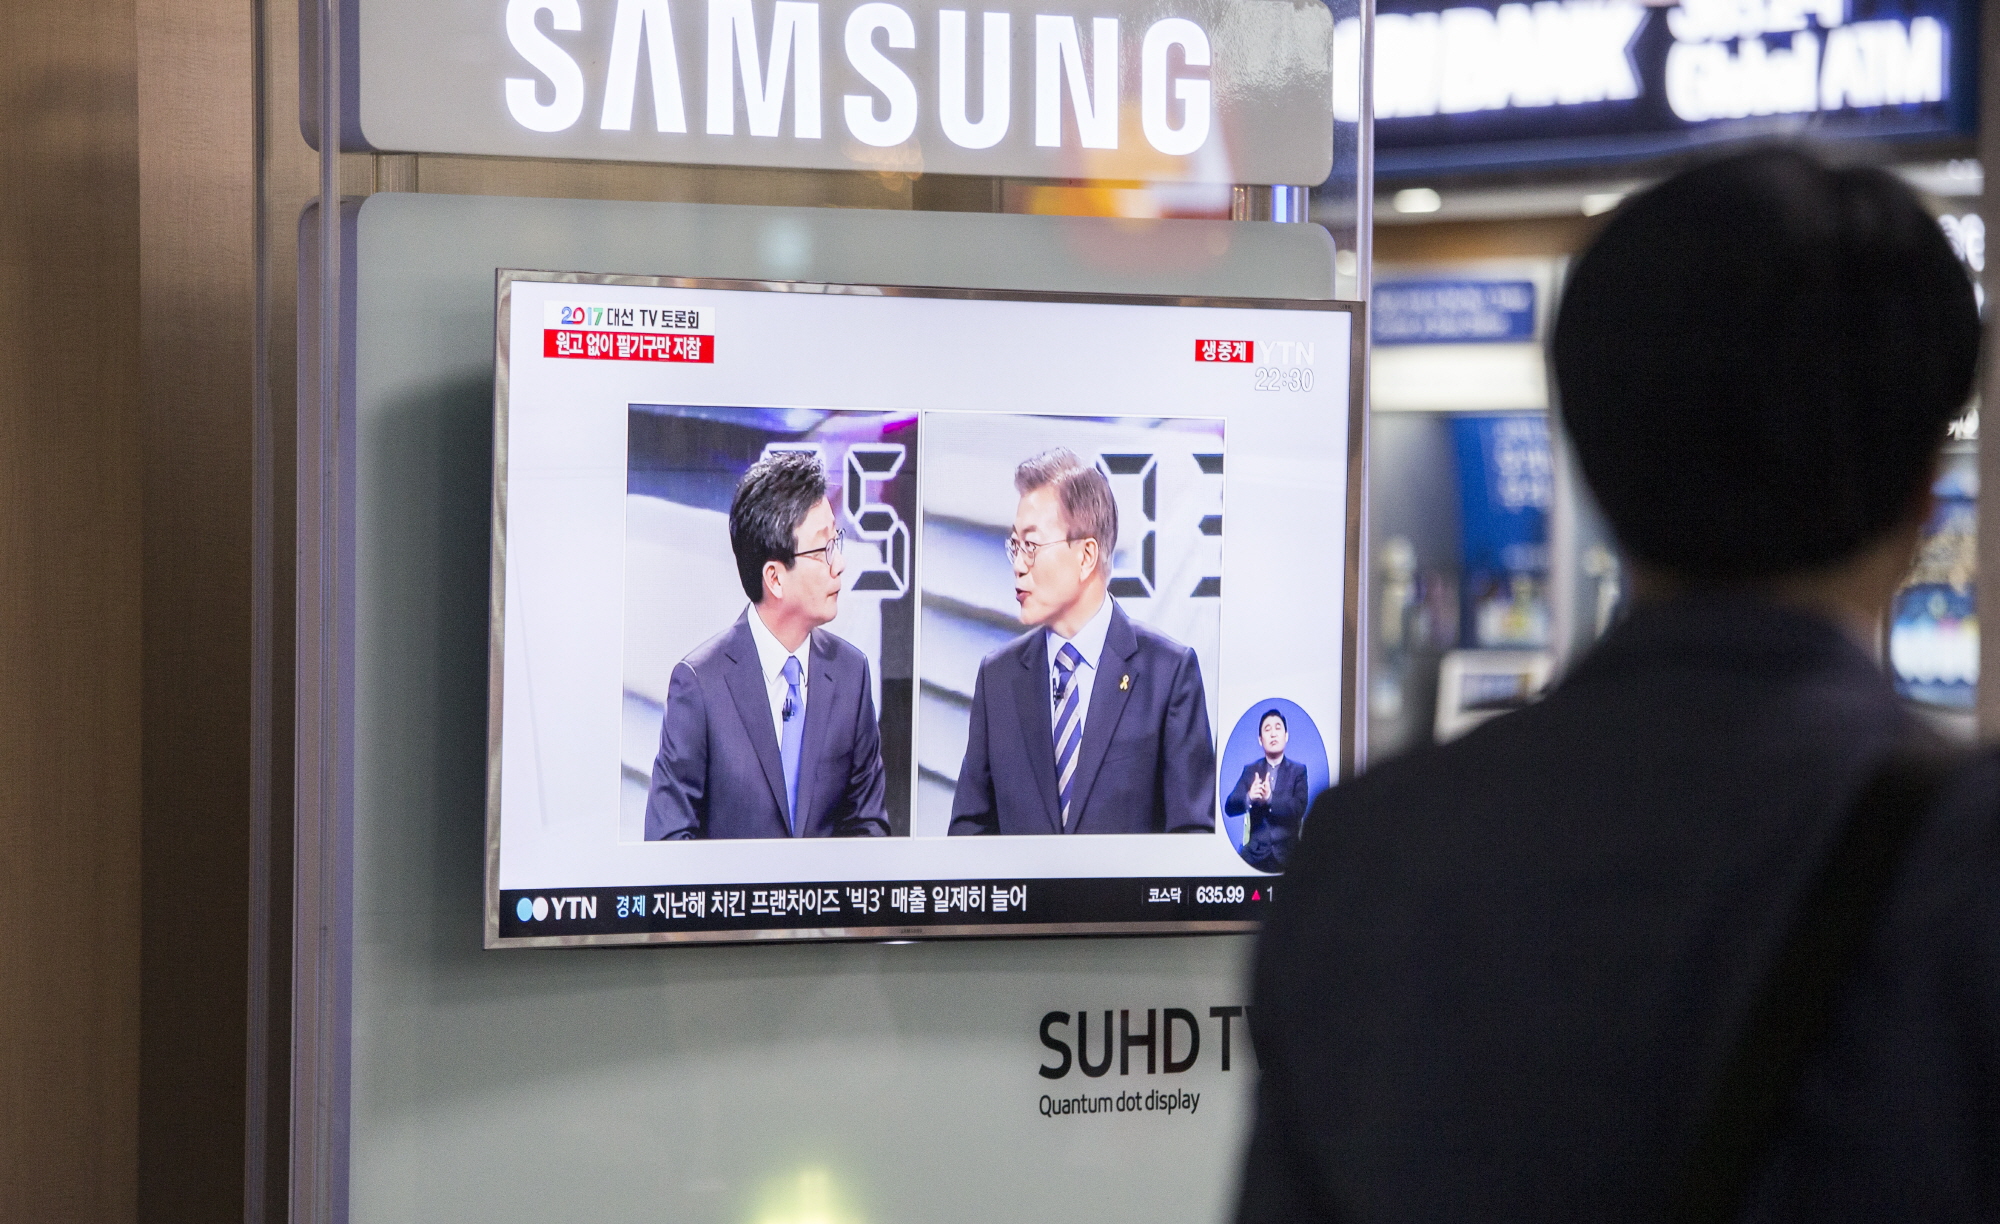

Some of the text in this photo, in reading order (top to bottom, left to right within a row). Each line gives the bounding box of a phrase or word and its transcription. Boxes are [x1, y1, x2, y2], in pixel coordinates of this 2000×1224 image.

[504, 0, 1211, 155] SAMSUNG
[561, 306, 699, 330] 2017 대선 TV 토론회
[556, 331, 702, 360] 원고 없이 필기구만 지참
[1202, 340, 1315, 366] 생중계 YTN
[1255, 366, 1314, 392] 22:30
[551, 884, 1027, 920] YTN 경제 지난해 치킨 프랜차이즈 '빅3' 매출 일제히 늘어
[1148, 887, 1182, 904] 코스닥
[1196, 885, 1245, 904] 635.99
[1038, 1005, 1262, 1080] SUHD T
[1039, 1088, 1200, 1118] Quantum dot display
